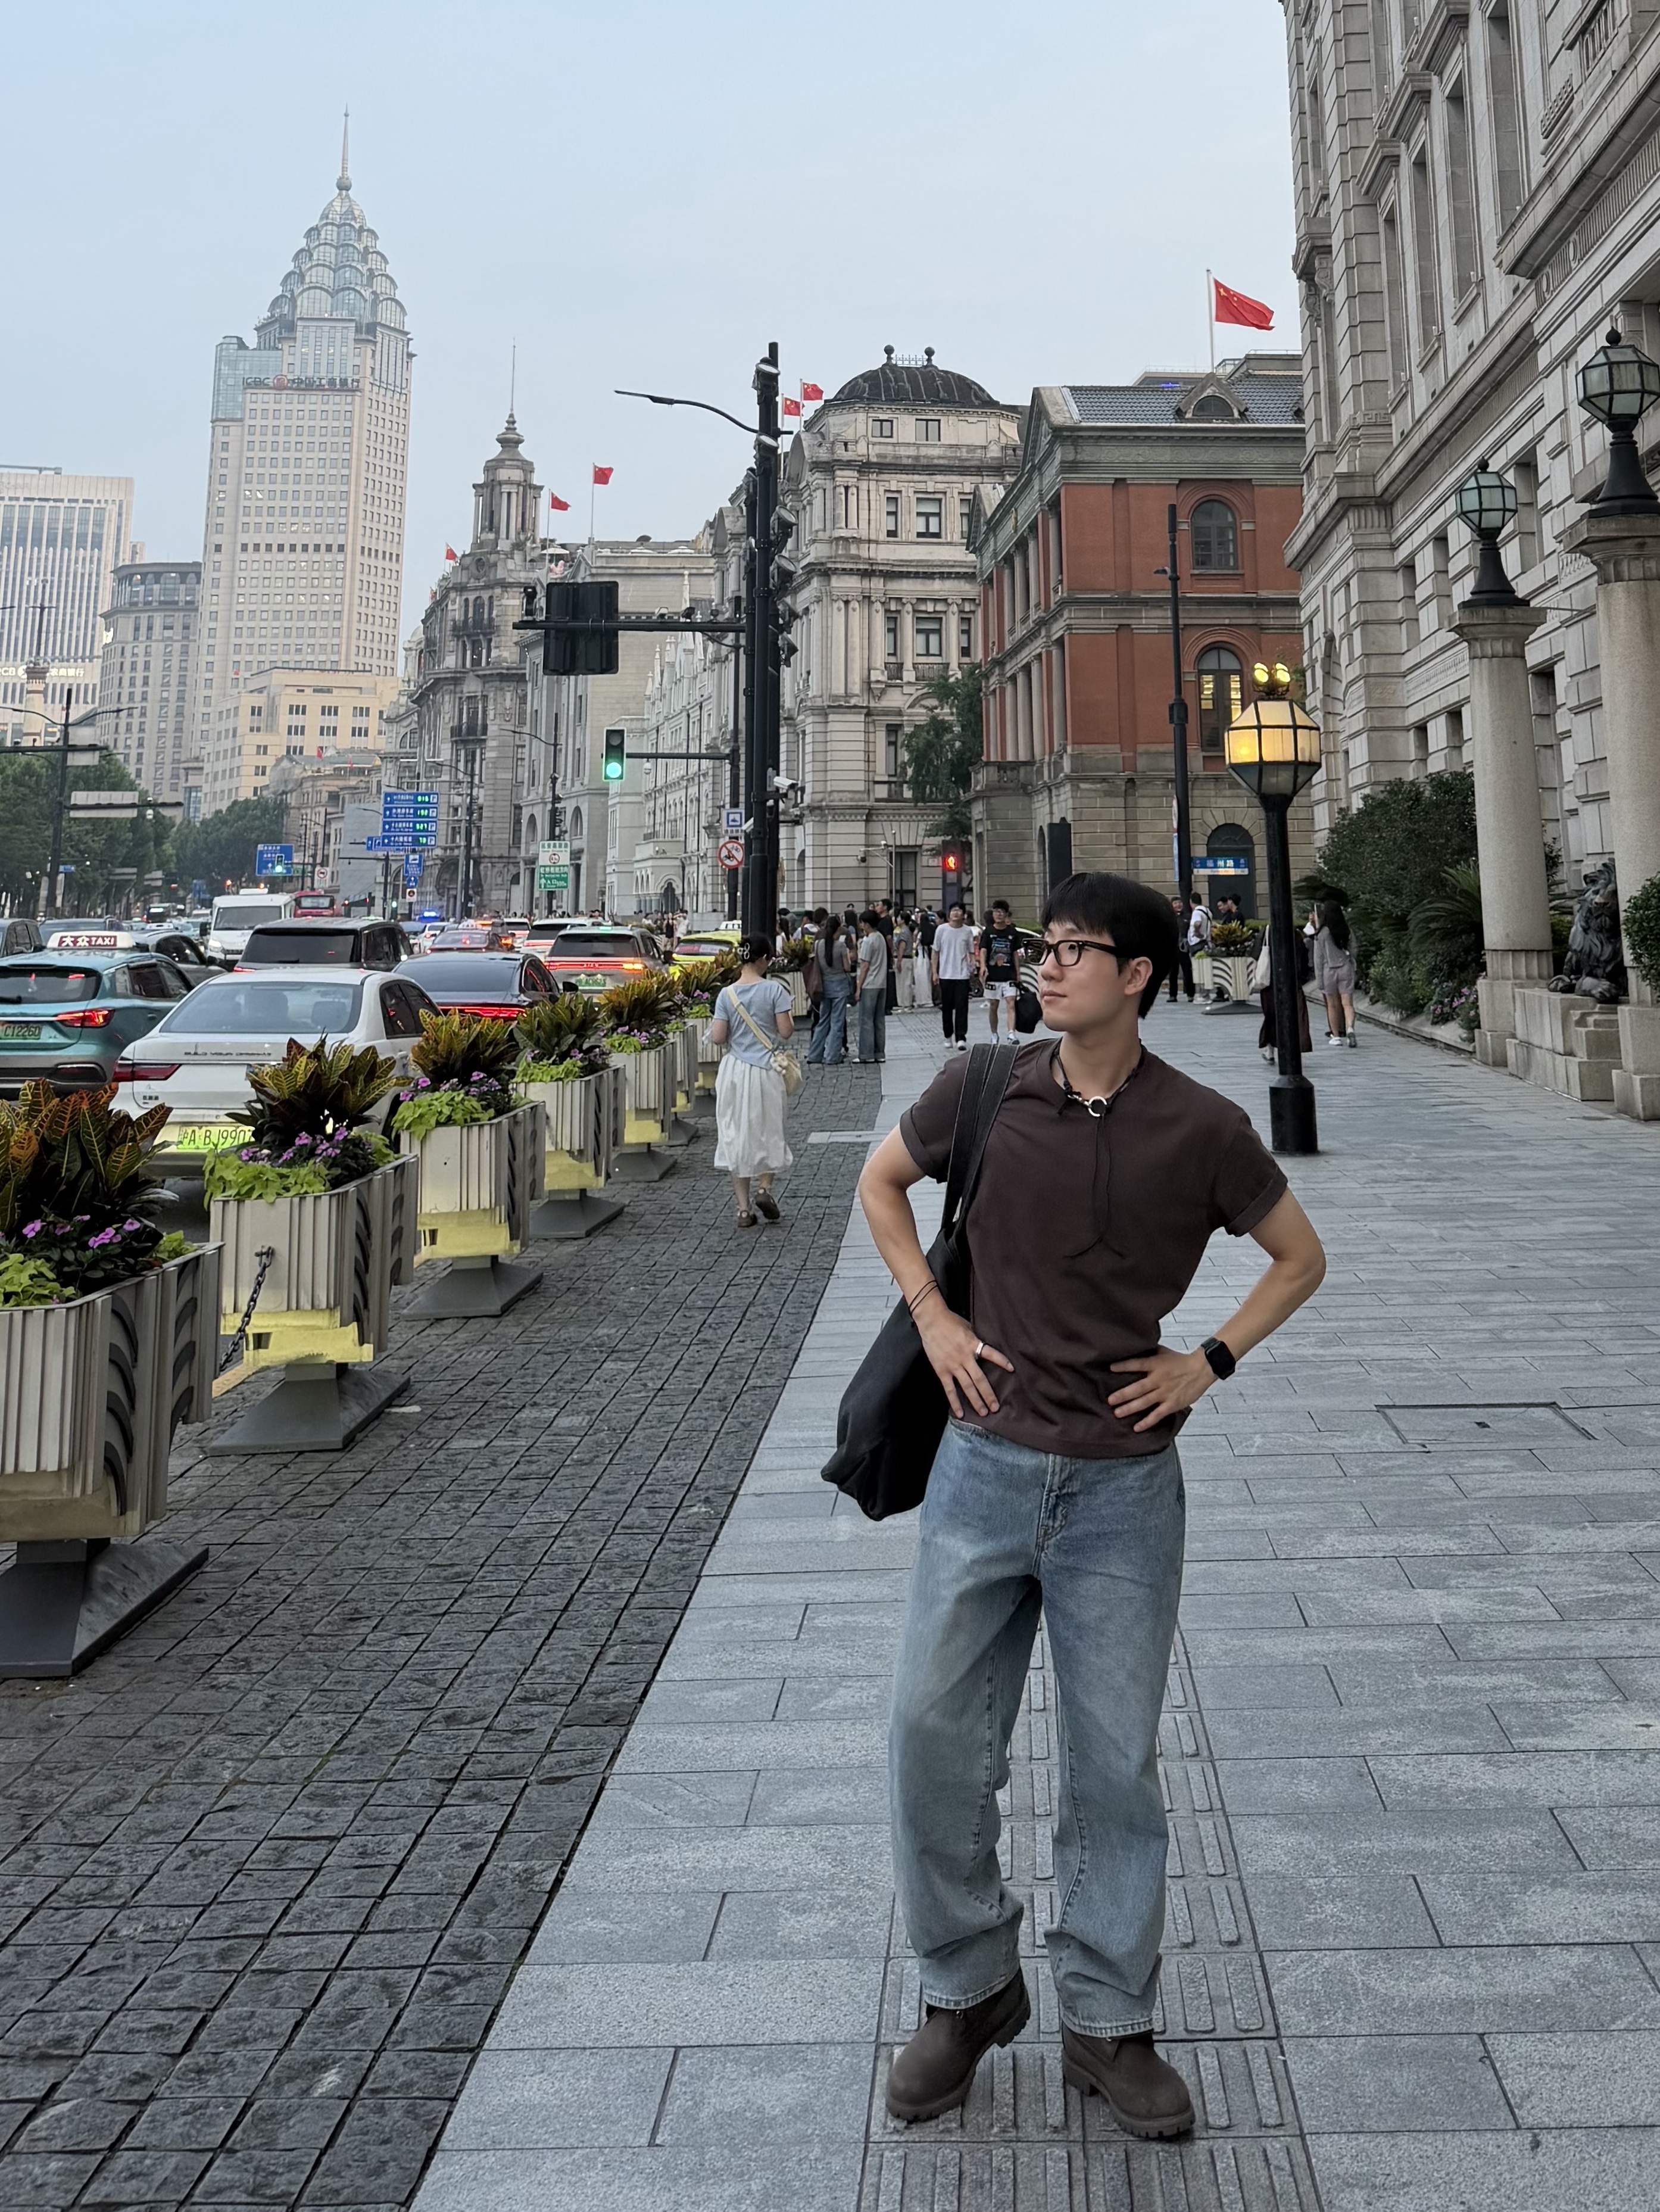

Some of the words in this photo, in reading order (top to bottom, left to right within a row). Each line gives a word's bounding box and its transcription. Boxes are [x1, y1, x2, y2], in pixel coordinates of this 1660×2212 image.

[242, 377, 271, 386] ICBC
[0, 668, 16, 676] CB
[46, 668, 84, 677] 农商银行
[61, 936, 89, 946] 大众
[91, 937, 114, 945] TAXI
